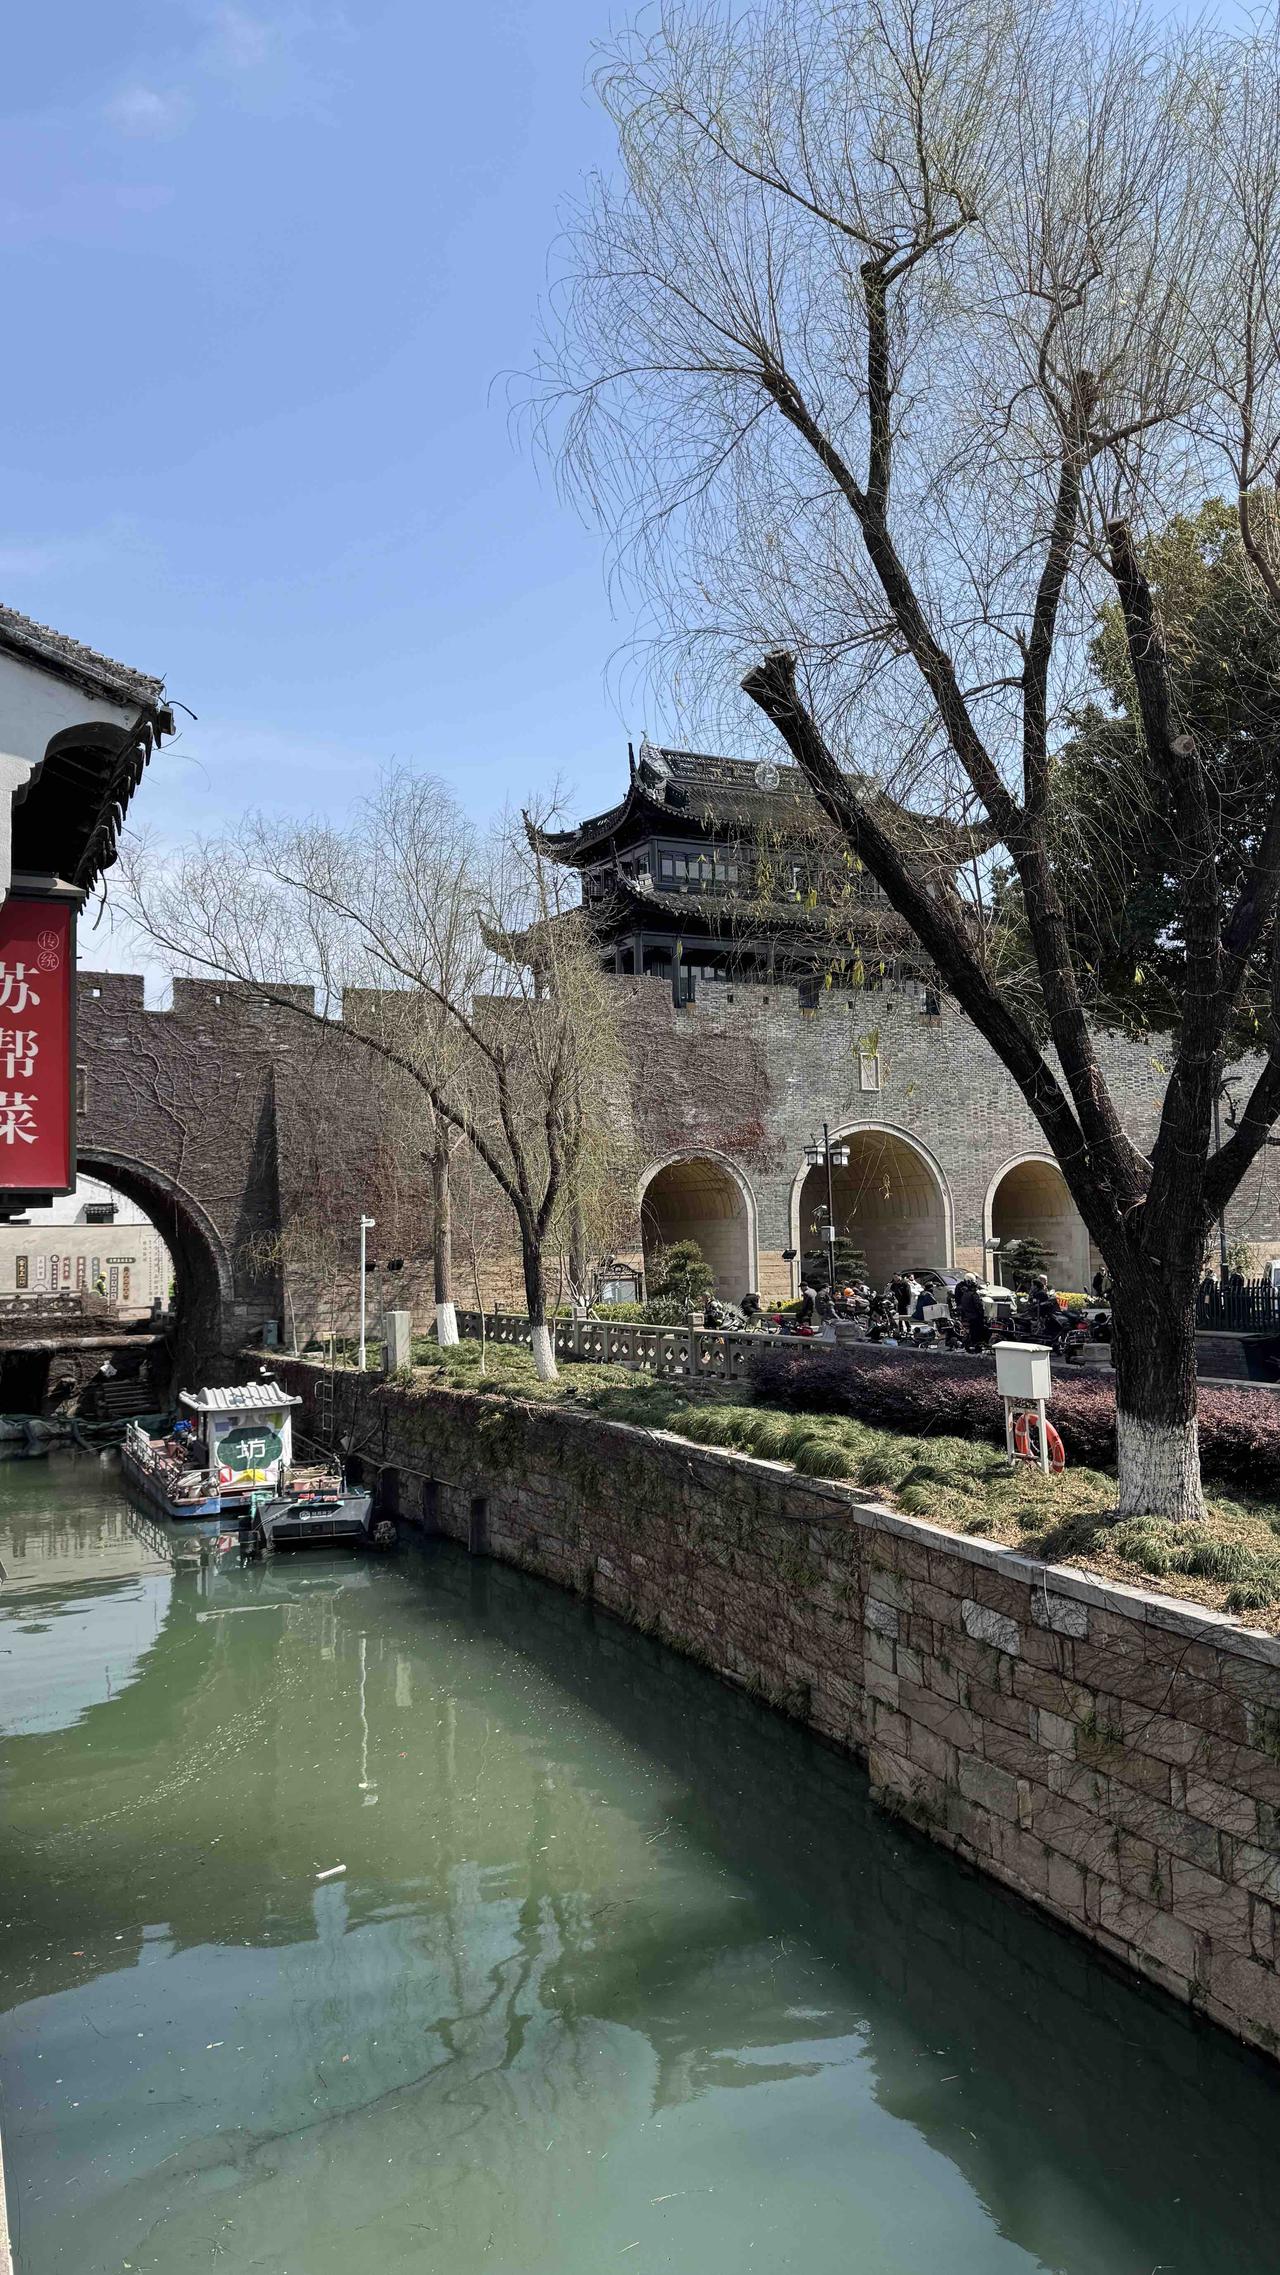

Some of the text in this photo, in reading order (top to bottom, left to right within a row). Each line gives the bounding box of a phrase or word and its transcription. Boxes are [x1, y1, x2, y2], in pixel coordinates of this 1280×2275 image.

[39, 931, 58, 970] 传统
[0, 962, 40, 1144] 苏帮菜
